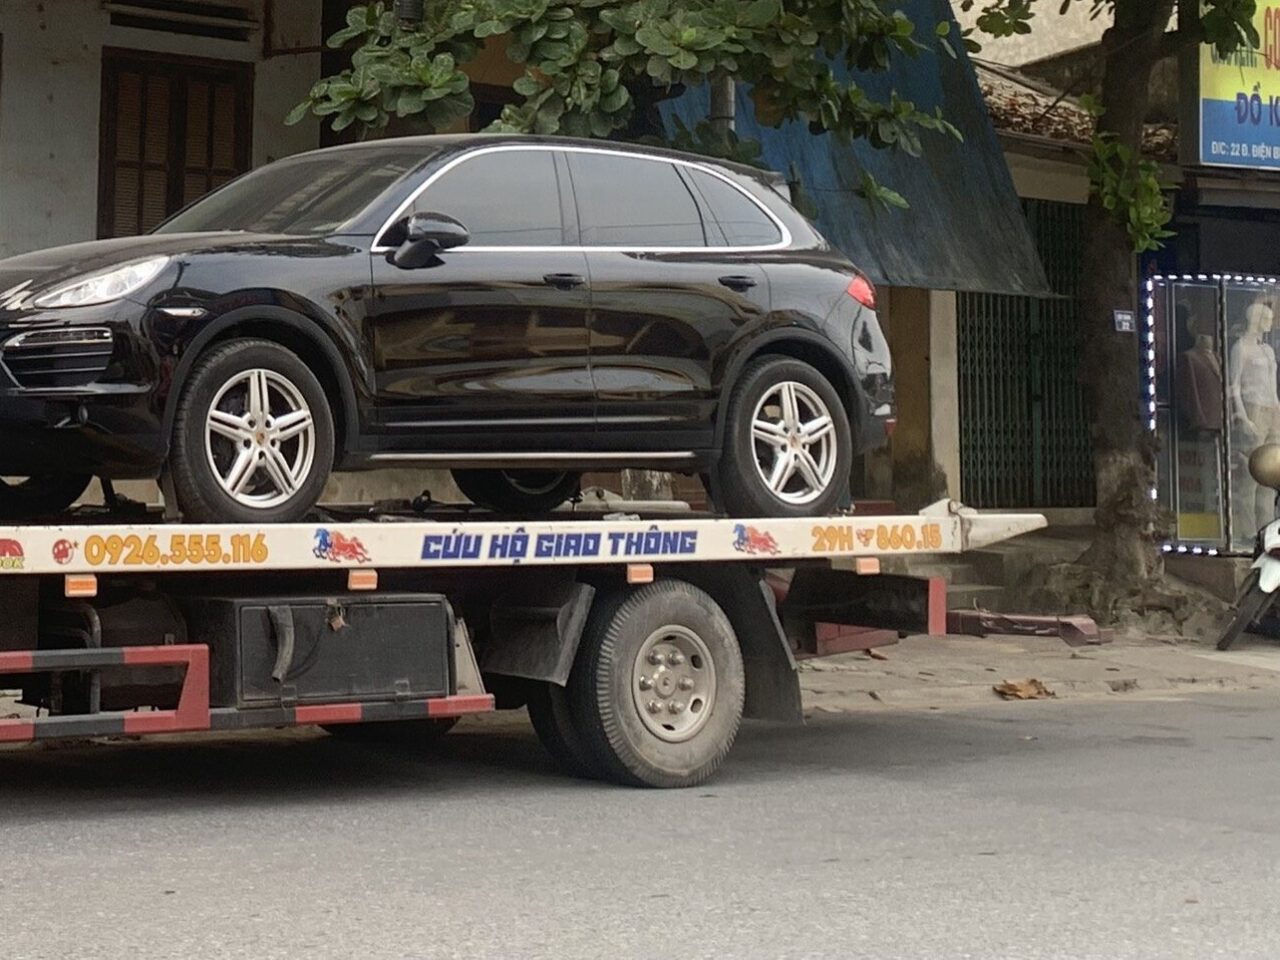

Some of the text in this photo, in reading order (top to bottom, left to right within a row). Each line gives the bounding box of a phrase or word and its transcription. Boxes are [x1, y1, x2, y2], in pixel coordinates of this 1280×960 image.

[83, 532, 269, 566] 0926.555.116
[420, 524, 699, 565] CỨU HỘ GIAO THÔNG
[811, 523, 943, 552] 29H 860.15
